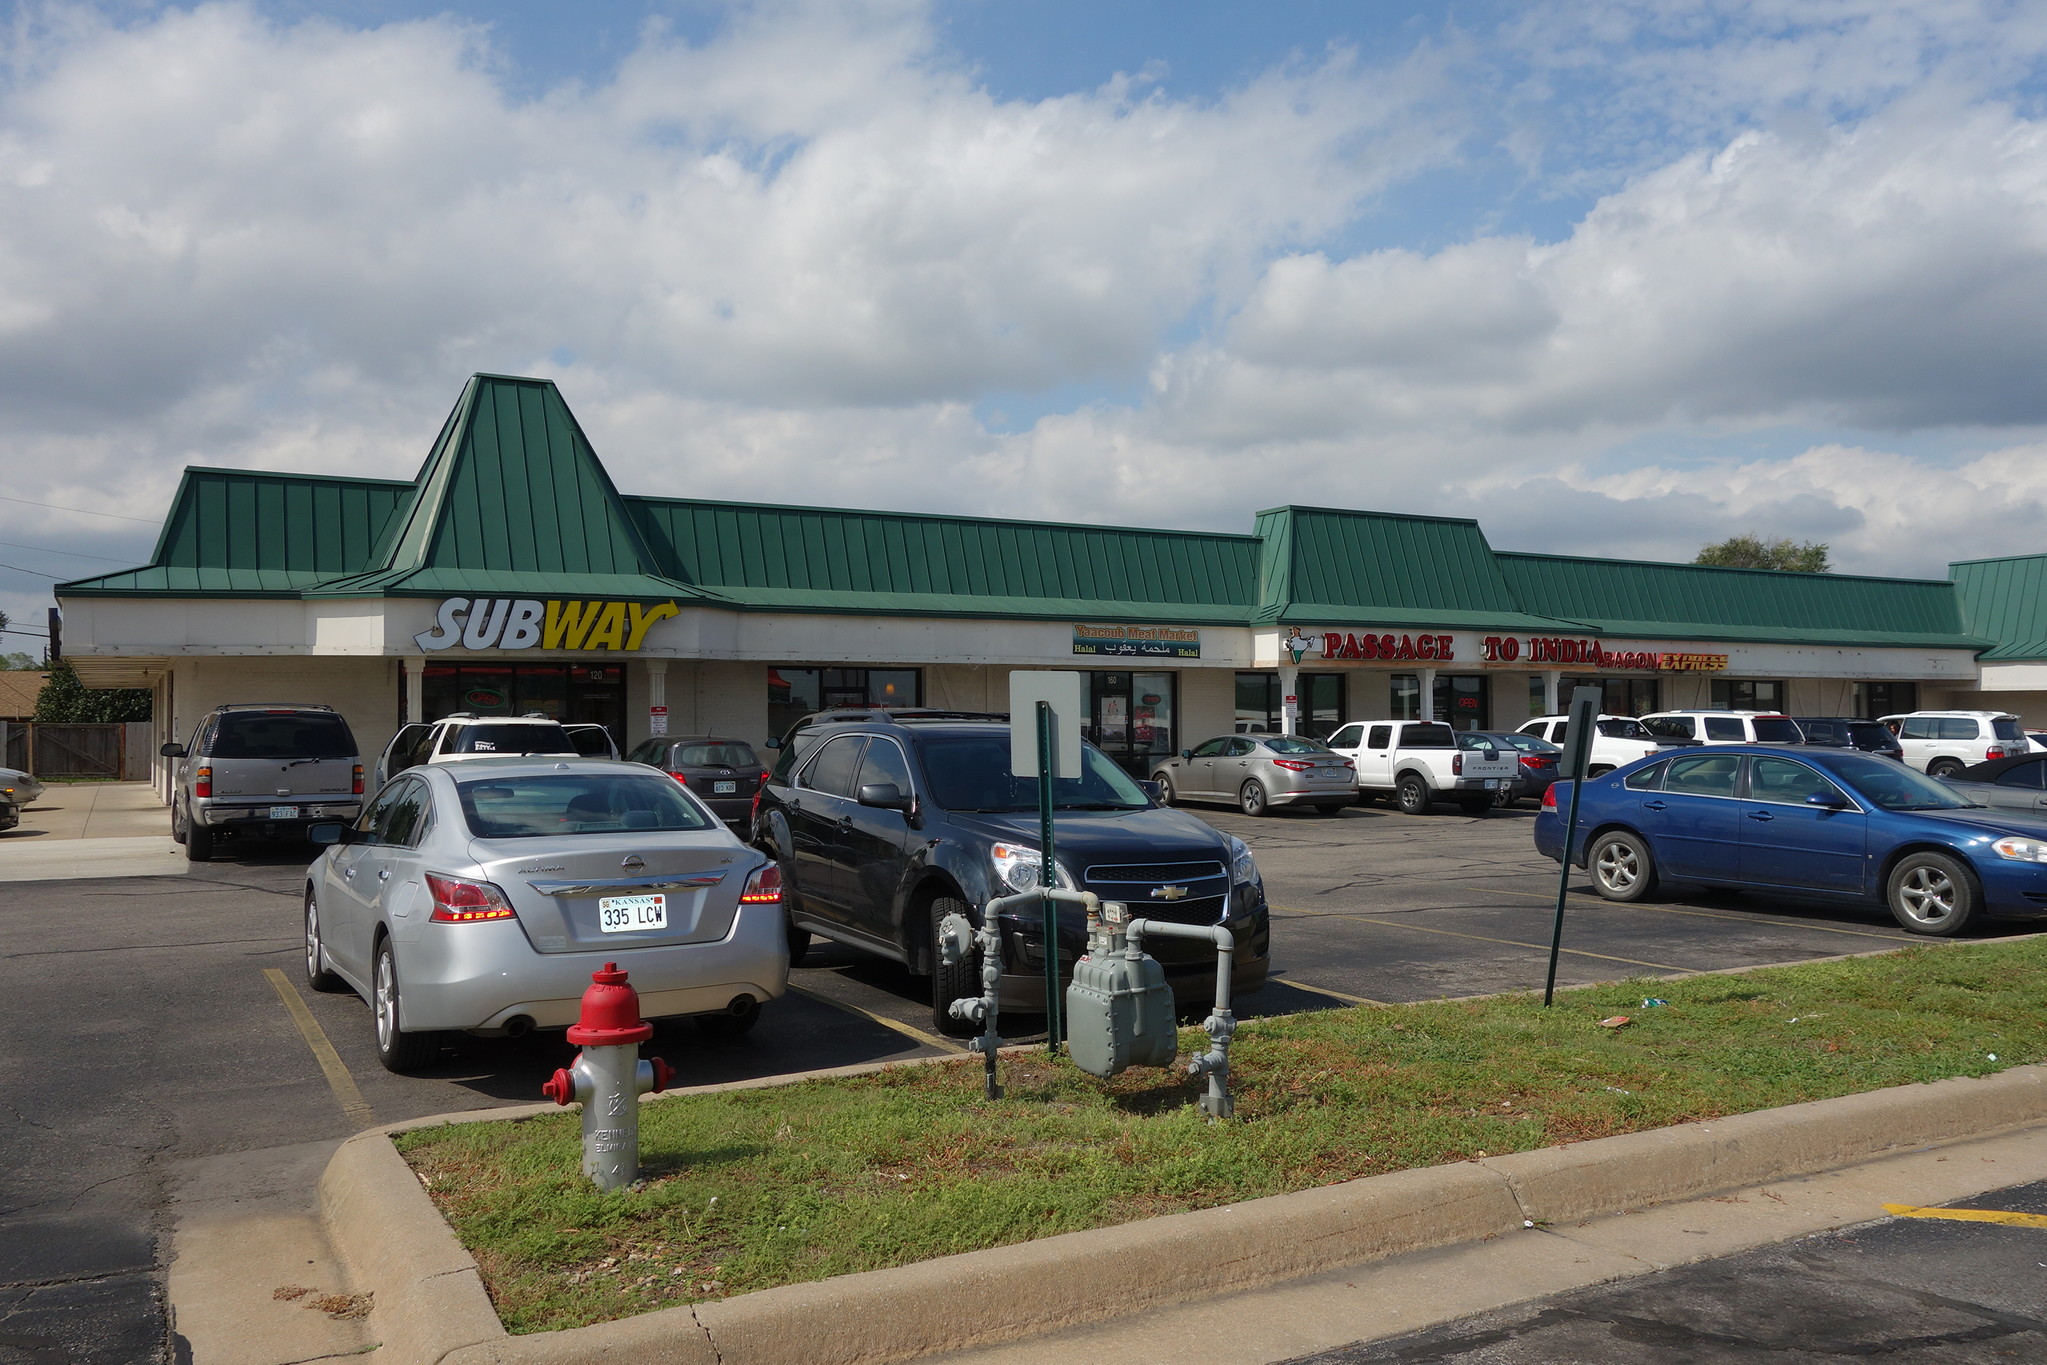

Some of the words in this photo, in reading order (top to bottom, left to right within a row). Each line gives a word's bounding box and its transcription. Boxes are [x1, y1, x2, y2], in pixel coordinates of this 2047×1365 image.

[413, 597, 681, 653] SUBWAY
[1075, 625, 1125, 638] Yaacoub
[1127, 627, 1158, 640] Meat
[1158, 628, 1199, 642] Market
[1074, 644, 1096, 653] Halal
[1105, 640, 1137, 655] يعقوب
[1141, 640, 1171, 653] ملحمة
[1178, 648, 1198, 657] Halal
[1322, 632, 1454, 661] PASSAGE
[1483, 635, 1520, 662] TO
[1528, 637, 1604, 665] INDIA
[1659, 653, 1729, 671] EXPRESS
[590, 670, 603, 680] 120
[470, 690, 500, 707] OPEN
[1459, 697, 1478, 709] OPEN
[517, 865, 566, 874] ALTIMA
[604, 908, 630, 926] 335
[637, 905, 662, 924] LCW
